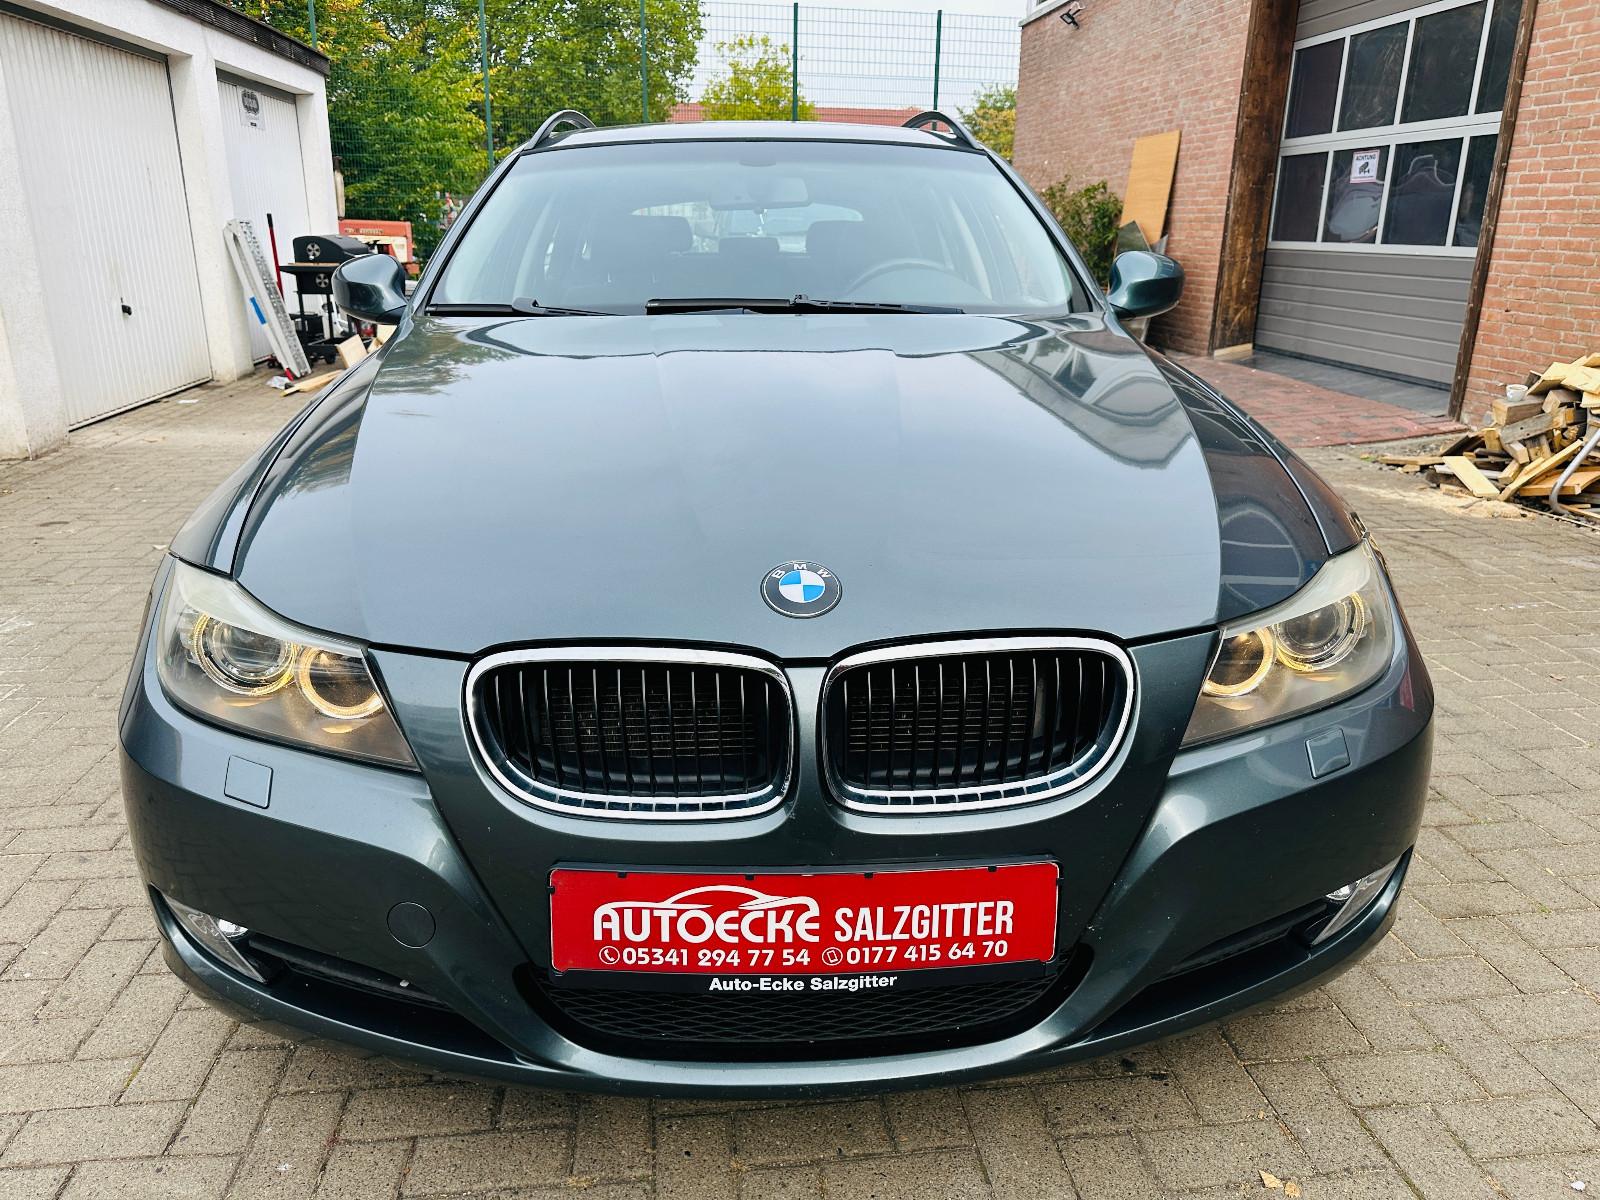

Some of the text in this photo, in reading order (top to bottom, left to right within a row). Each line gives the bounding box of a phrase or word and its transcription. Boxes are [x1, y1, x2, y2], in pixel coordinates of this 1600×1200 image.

[771, 563, 831, 579] BMW
[593, 896, 1014, 944] AUTOECKE SALZGITTER
[622, 940, 1008, 967] 05341 294 77 54 0177 415 64 70
[709, 975, 897, 992] Auto-Ecke Salzgitter
